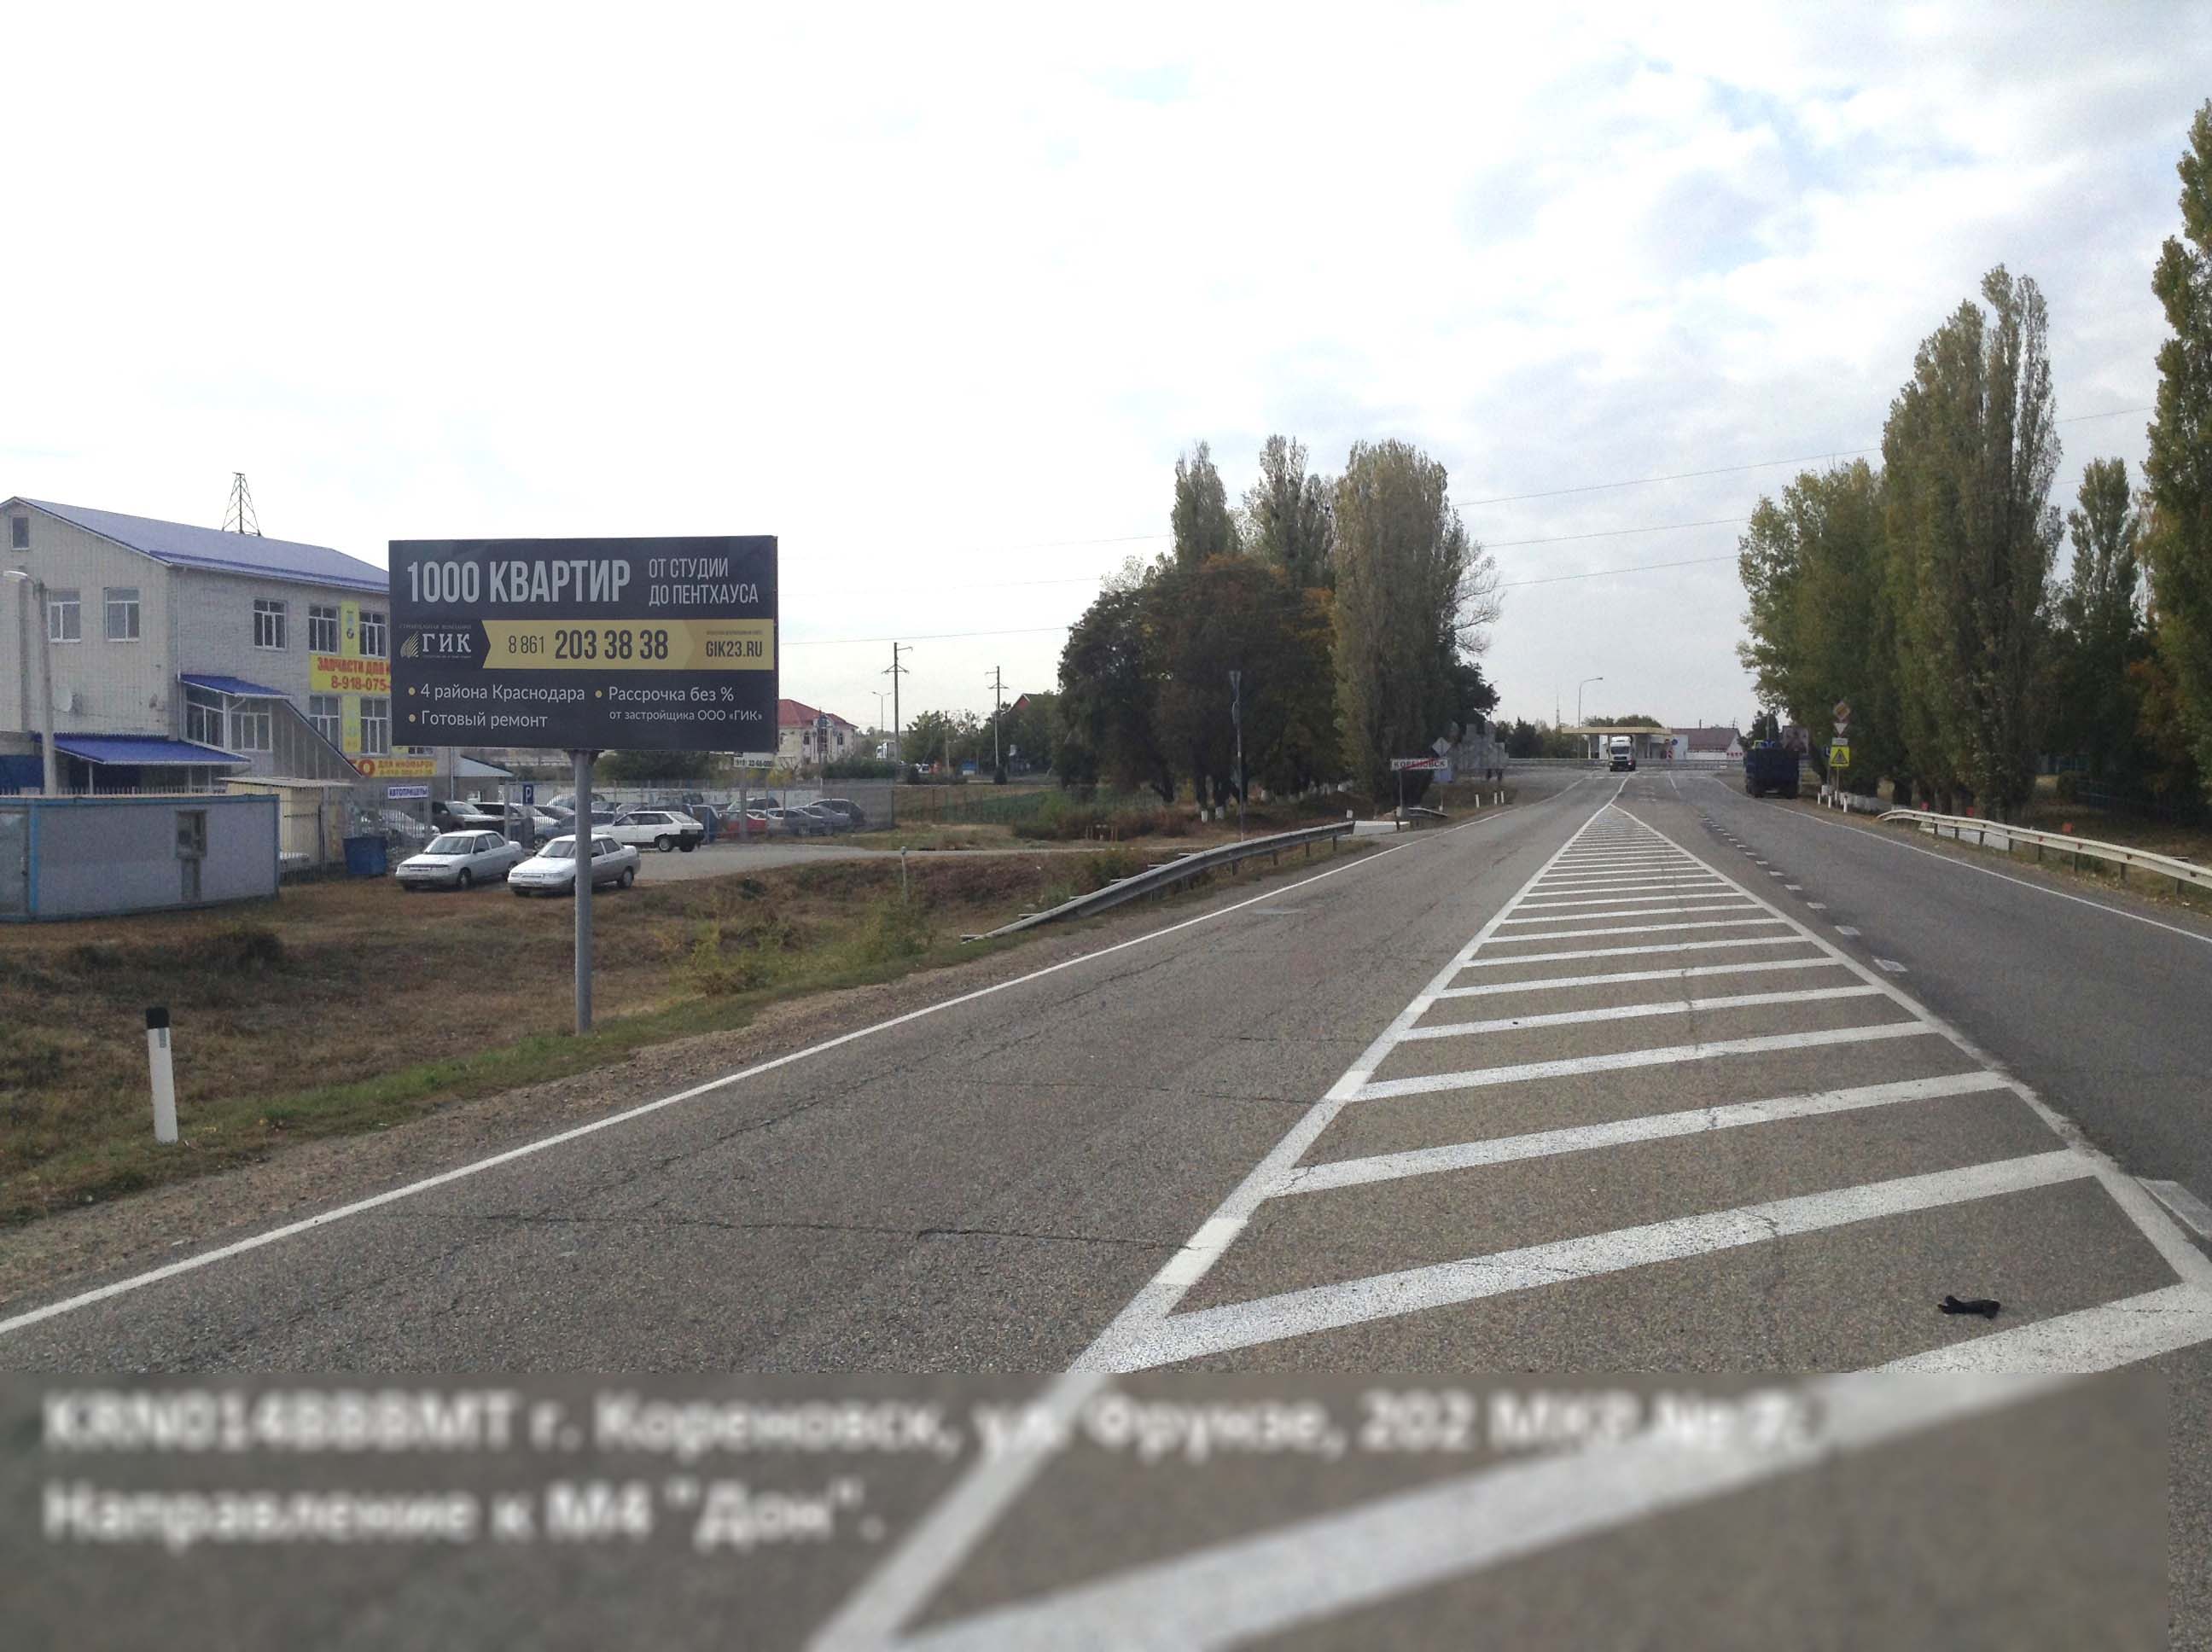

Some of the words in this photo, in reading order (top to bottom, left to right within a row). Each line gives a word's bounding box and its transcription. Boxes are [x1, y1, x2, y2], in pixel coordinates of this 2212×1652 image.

[649, 559, 667, 578] ОТ
[670, 558, 729, 580] СТУДИИ
[407, 561, 480, 603] 1000
[489, 560, 632, 602] КВАРТИР
[649, 585, 670, 607] ДО
[672, 584, 759, 605] ПЕНТХАУСА
[422, 633, 472, 653] ГИК
[508, 635, 517, 654] 8
[520, 635, 544, 654] 861
[555, 629, 597, 660] 203
[604, 629, 633, 660] 38
[639, 629, 669, 660] 38
[706, 641, 763, 657] GIK23.RU
[420, 683, 430, 698] 4
[434, 684, 487, 701] района
[492, 684, 585, 703] Краснодара
[608, 687, 686, 703] Рассрочка
[690, 687, 717, 701] без
[720, 687, 735, 702] %
[422, 710, 486, 725] Готовый
[491, 713, 548, 730] ремонт
[609, 711, 621, 720] от
[624, 710, 695, 721] застройщика
[697, 709, 726, 721] ООО
[729, 709, 763, 721] «ГИК»
